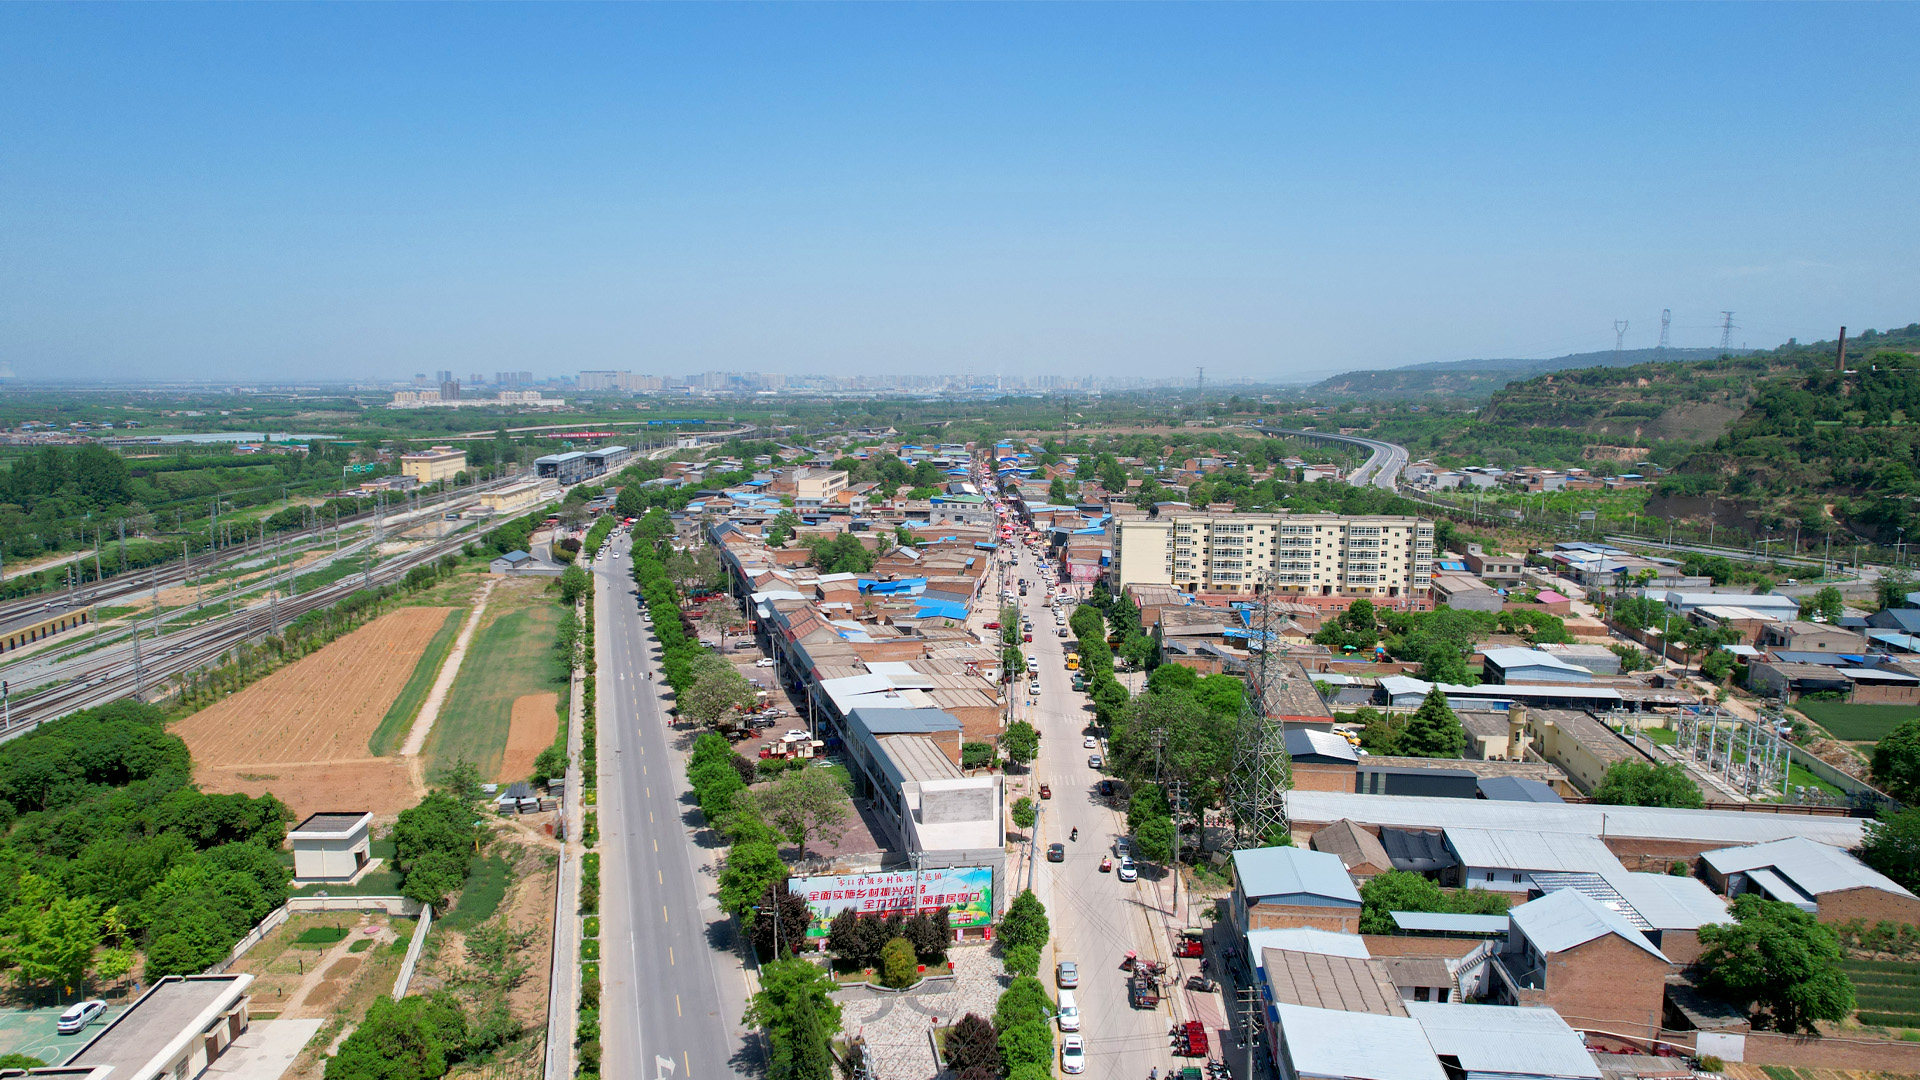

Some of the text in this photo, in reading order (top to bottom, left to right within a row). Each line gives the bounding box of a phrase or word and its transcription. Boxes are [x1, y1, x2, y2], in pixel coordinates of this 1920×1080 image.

[838, 873, 942, 886] 零口省级乡村振兴范镇
